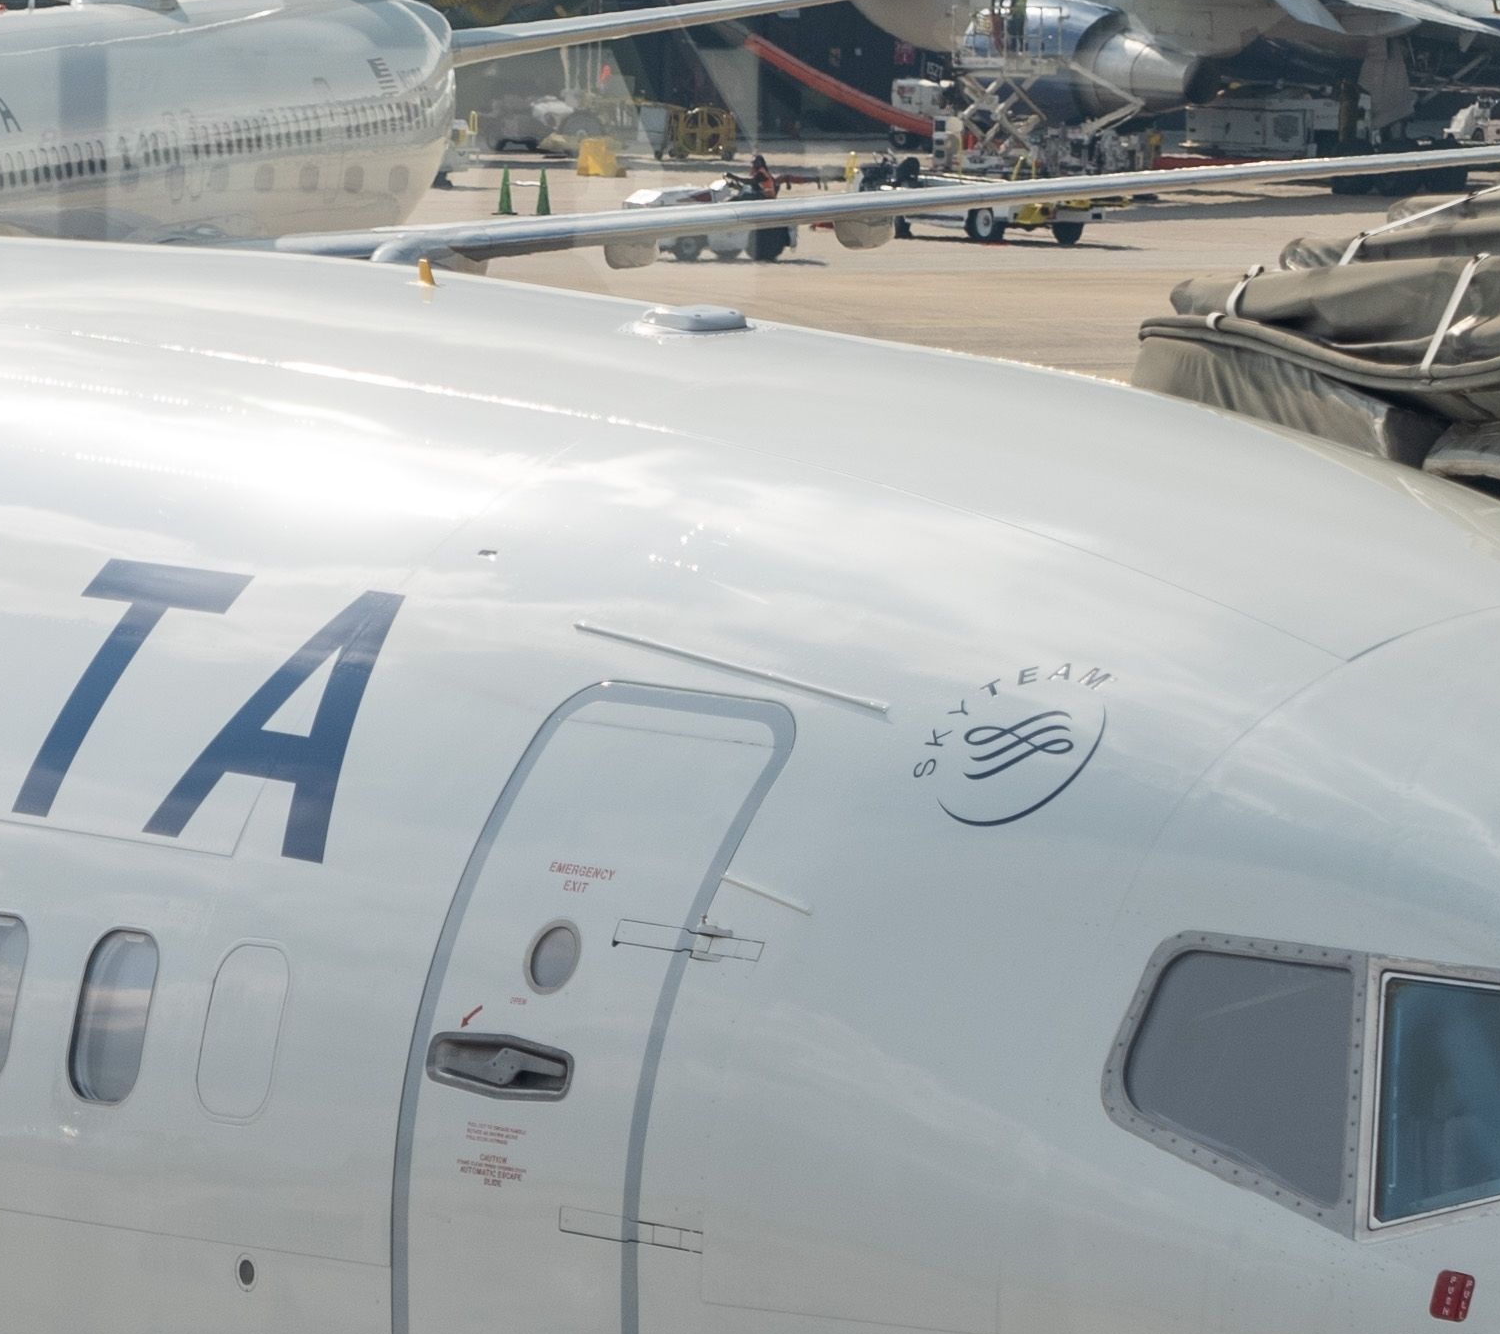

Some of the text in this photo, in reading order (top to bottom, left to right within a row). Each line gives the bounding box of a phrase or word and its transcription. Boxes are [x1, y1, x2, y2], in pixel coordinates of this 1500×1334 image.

[913, 663, 1112, 778] SKYTEAM
[549, 862, 616, 880] EMERGENCY
[563, 880, 589, 893] EXIT
